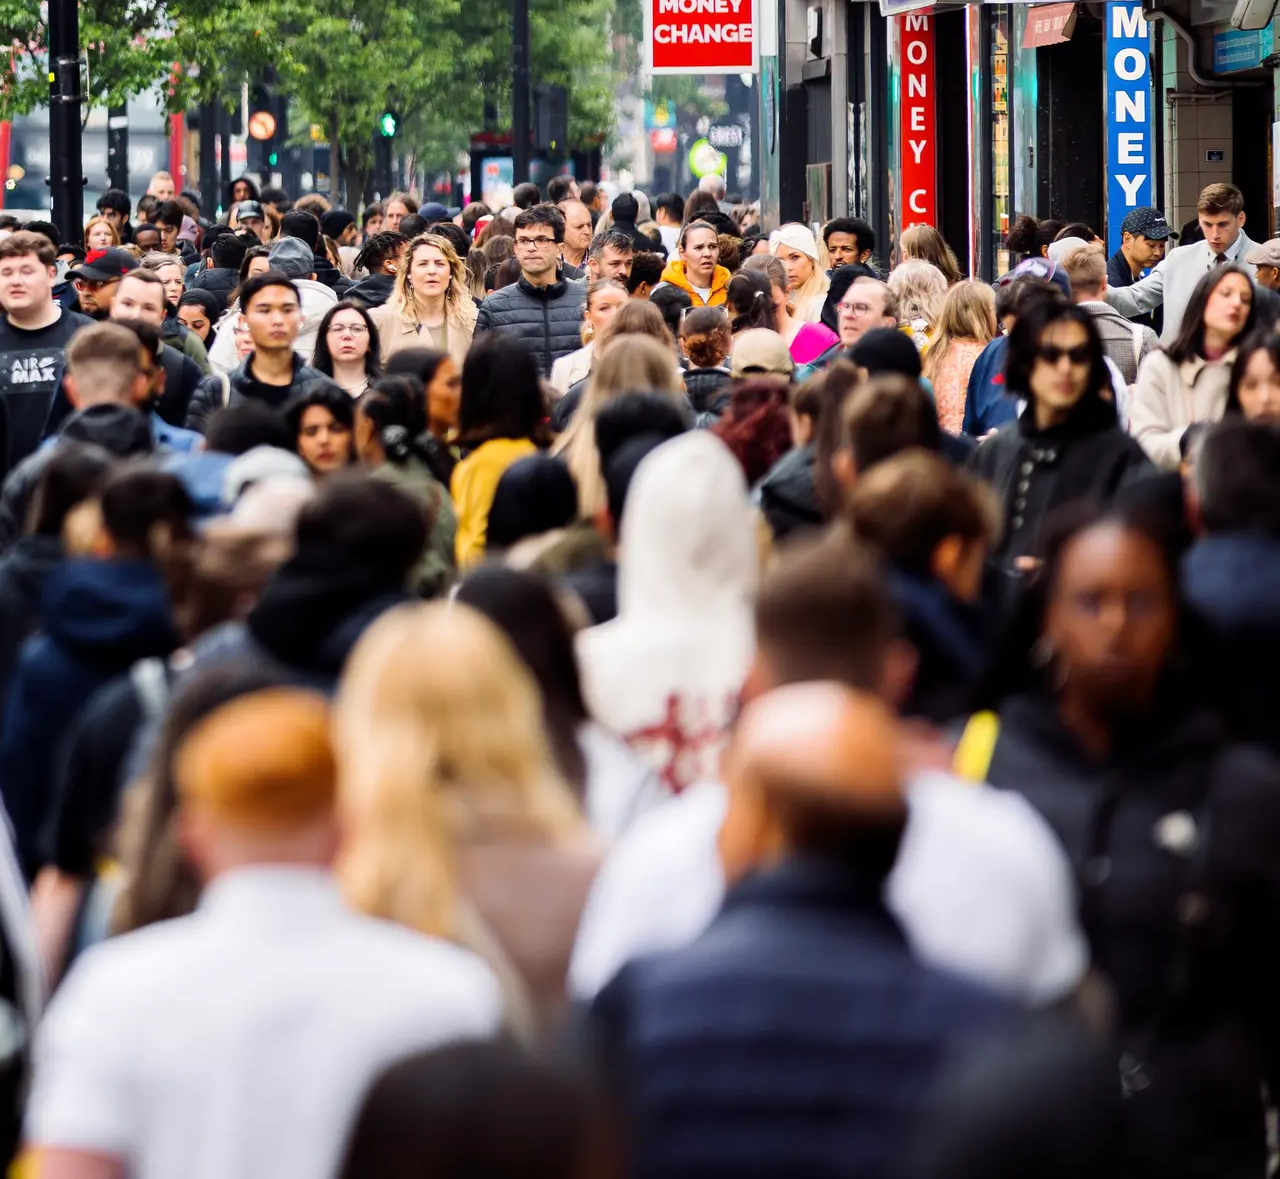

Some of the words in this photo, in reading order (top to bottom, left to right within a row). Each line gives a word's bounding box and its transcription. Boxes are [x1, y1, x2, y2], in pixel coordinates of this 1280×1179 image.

[654, 23, 753, 44] CHANGE
[905, 16, 929, 164] MONEY
[1111, 6, 1148, 206] MONEY
[11, 358, 40, 371] AIR
[11, 367, 56, 384] MAX
